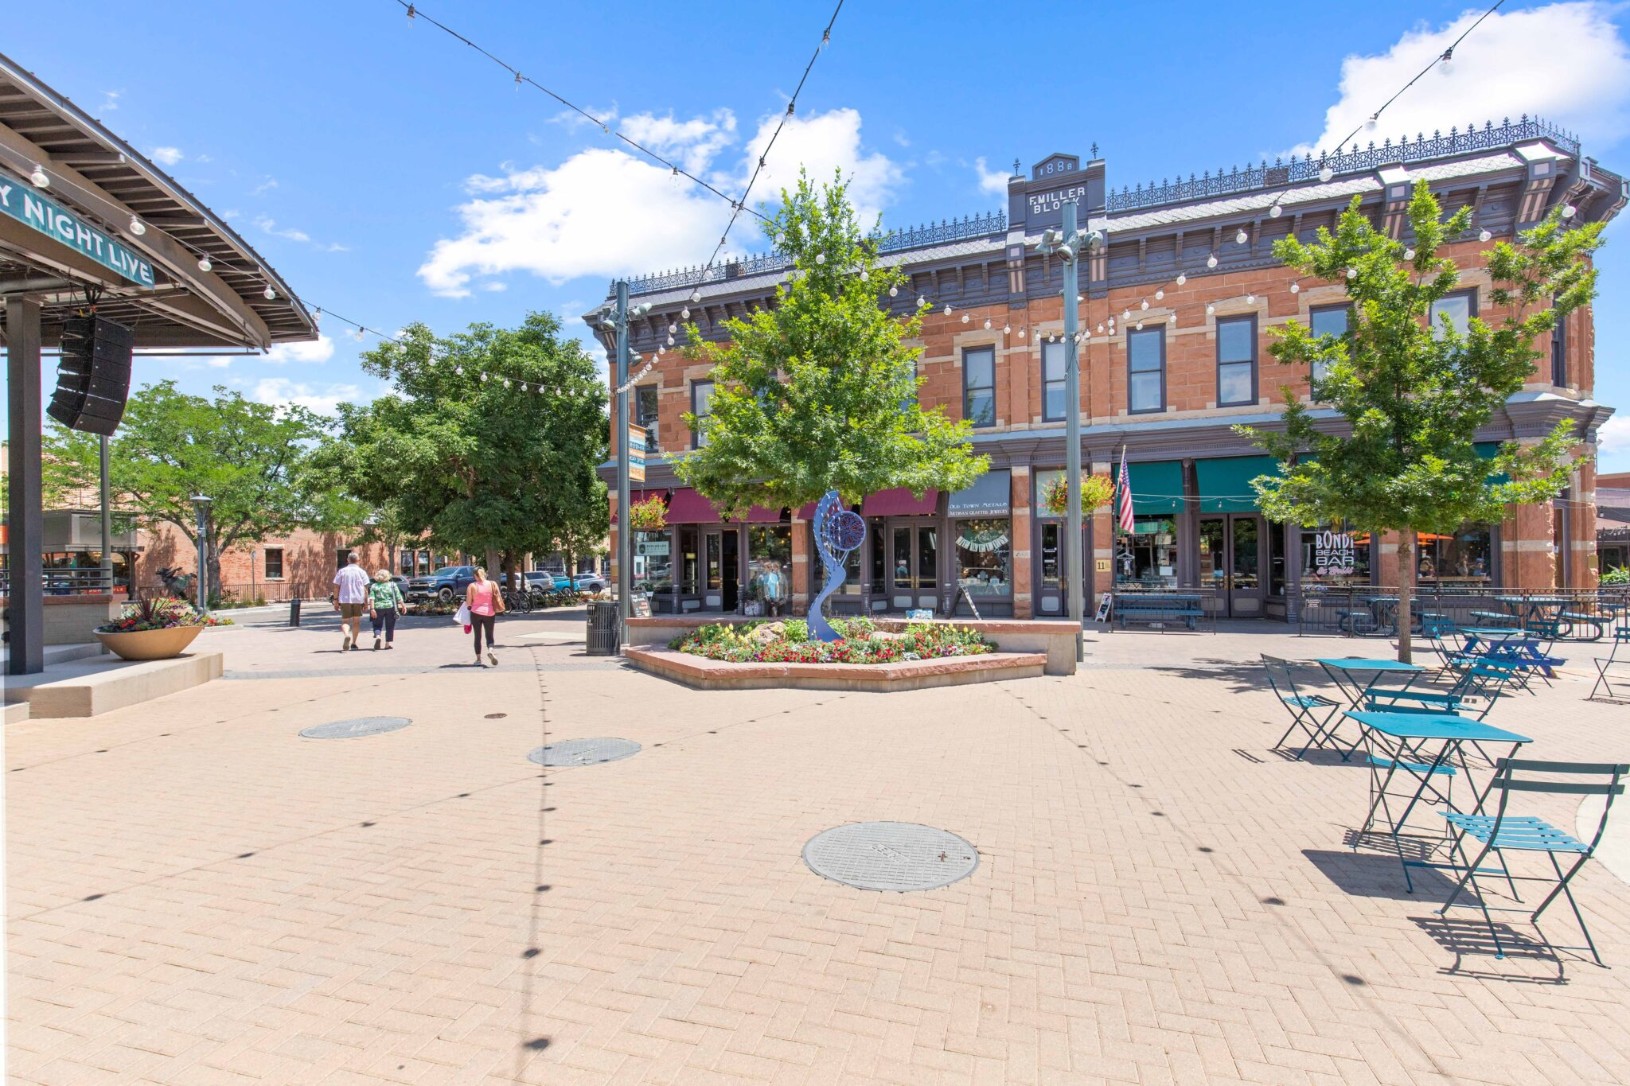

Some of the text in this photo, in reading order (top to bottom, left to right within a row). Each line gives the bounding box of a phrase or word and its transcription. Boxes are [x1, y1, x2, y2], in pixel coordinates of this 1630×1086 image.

[24, 193, 104, 257] NIGHT
[108, 243, 153, 284] LIVE
[1316, 557, 1354, 566] BAR
